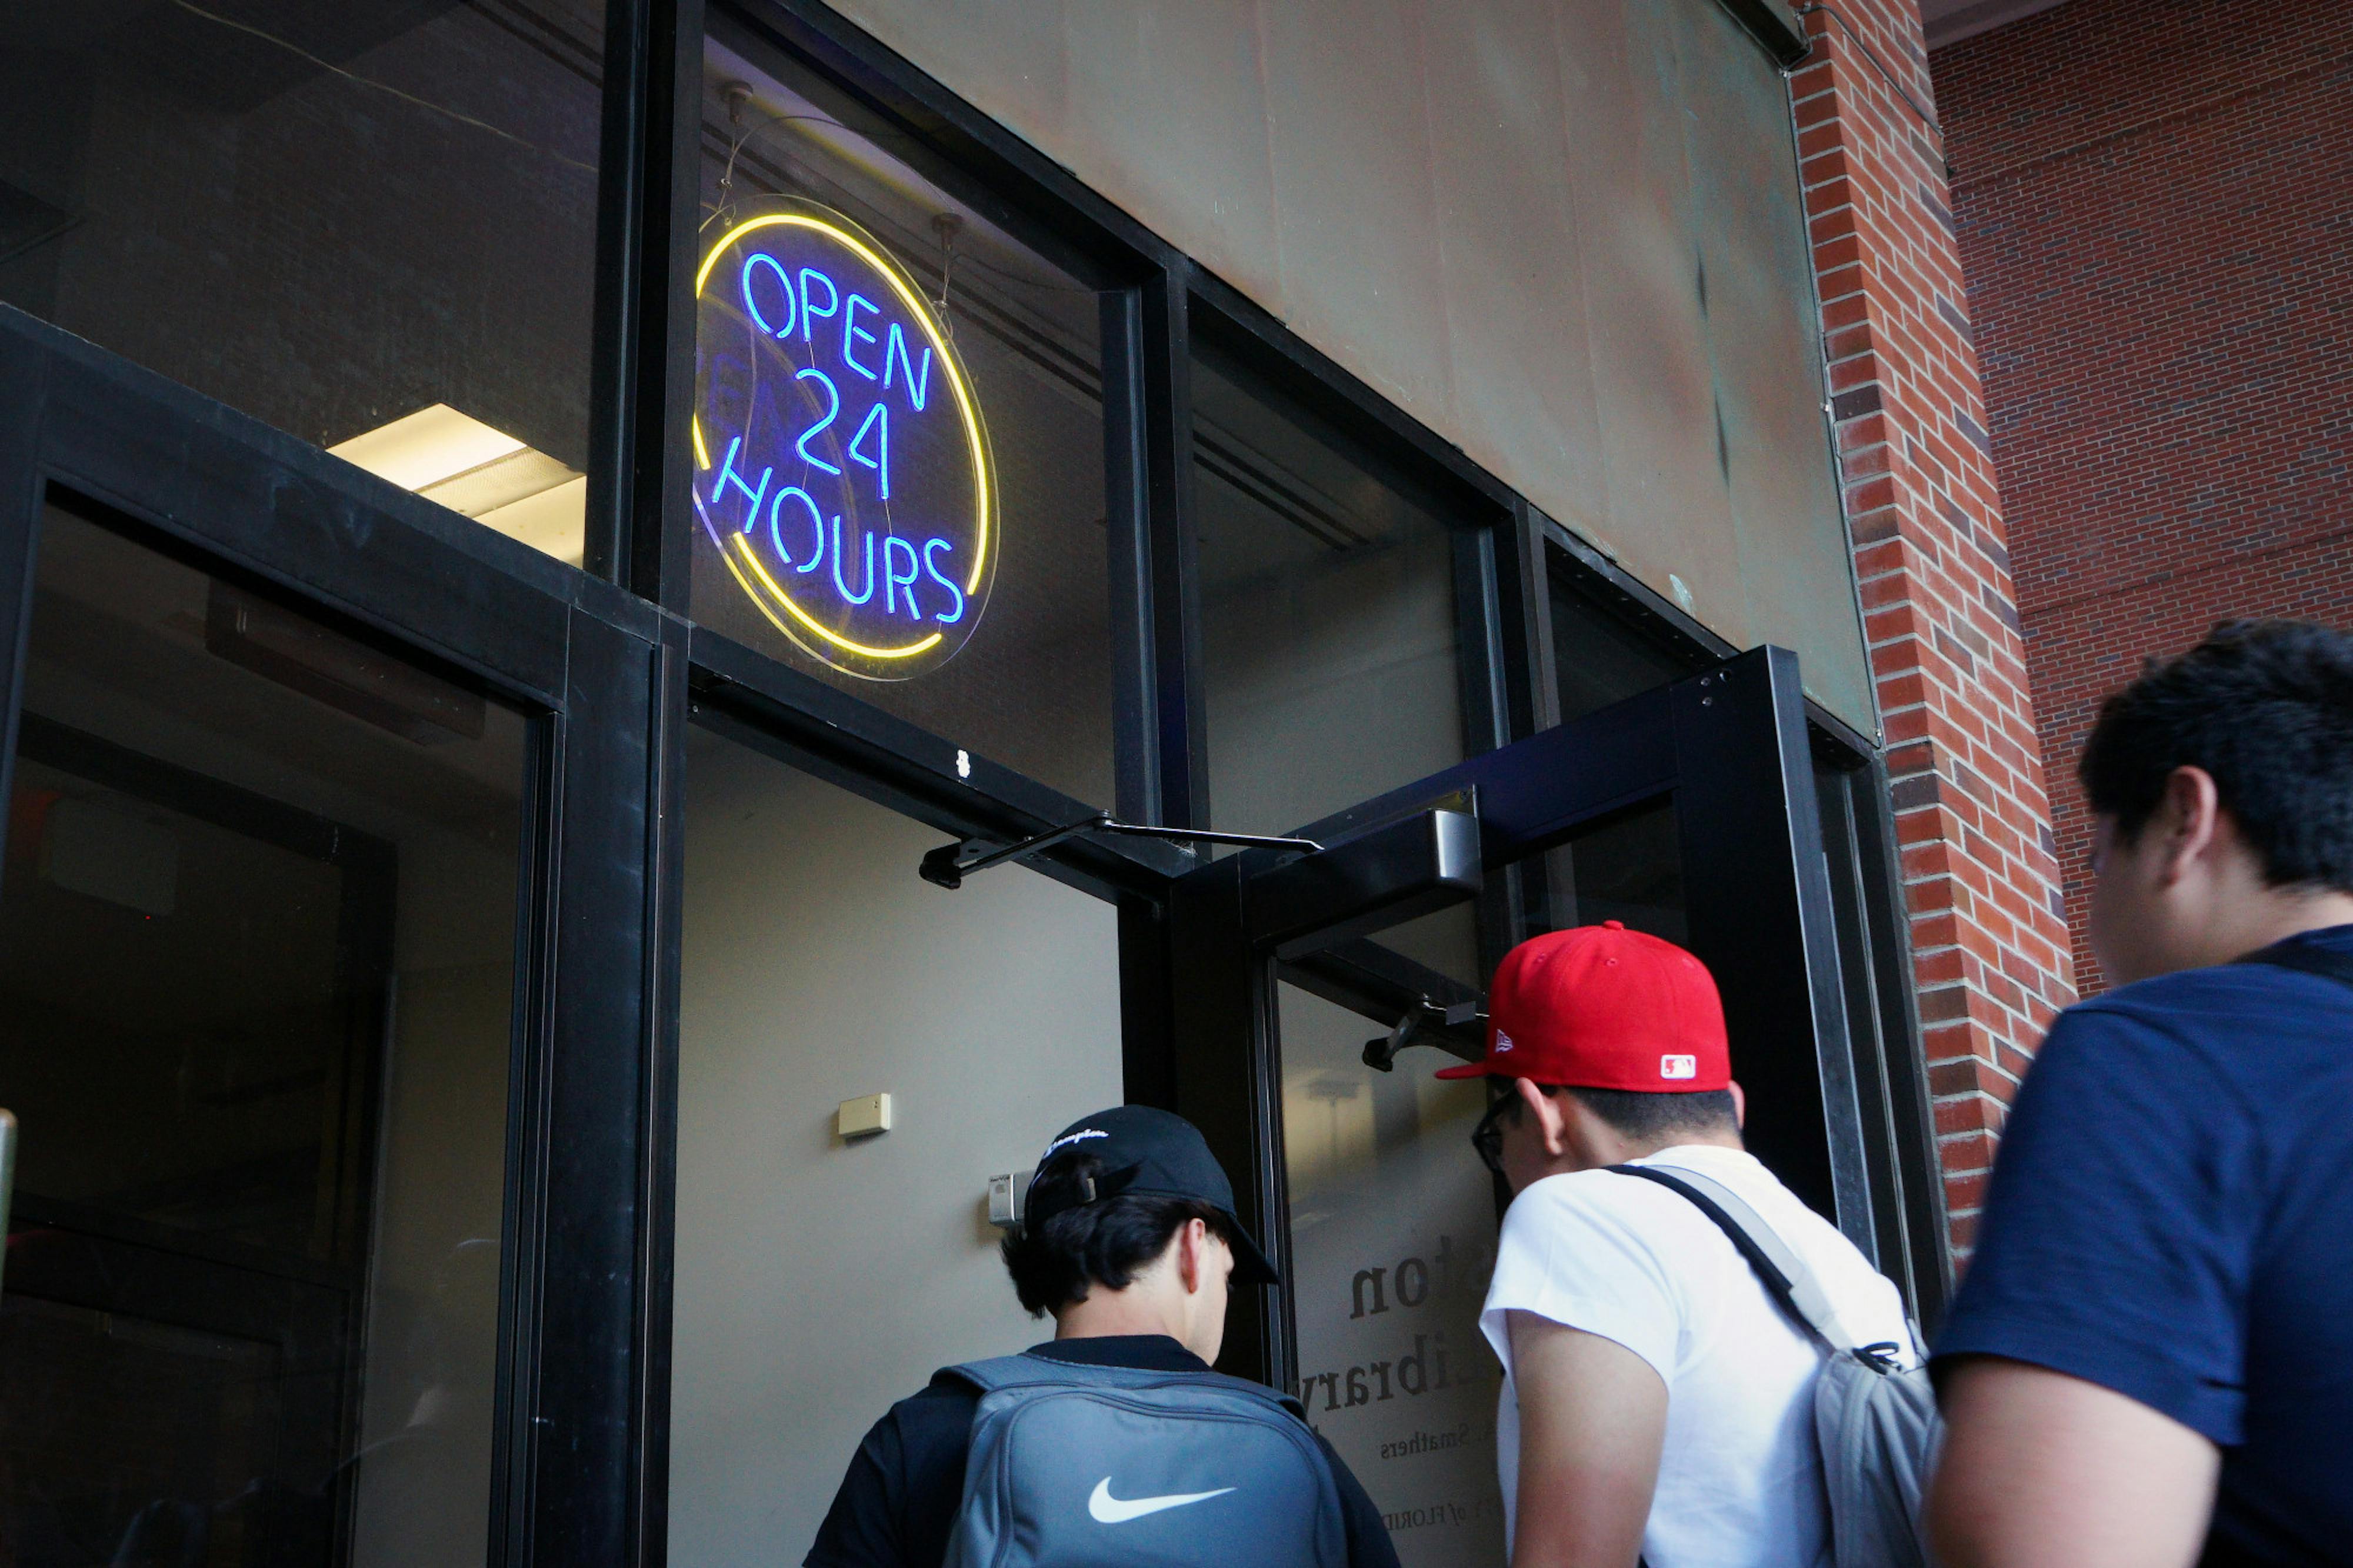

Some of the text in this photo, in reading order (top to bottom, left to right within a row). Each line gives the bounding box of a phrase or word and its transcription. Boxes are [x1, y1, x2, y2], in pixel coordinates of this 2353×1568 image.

[742, 252, 931, 412] OPEN
[795, 368, 889, 501] 24
[711, 436, 965, 623] HOURS
